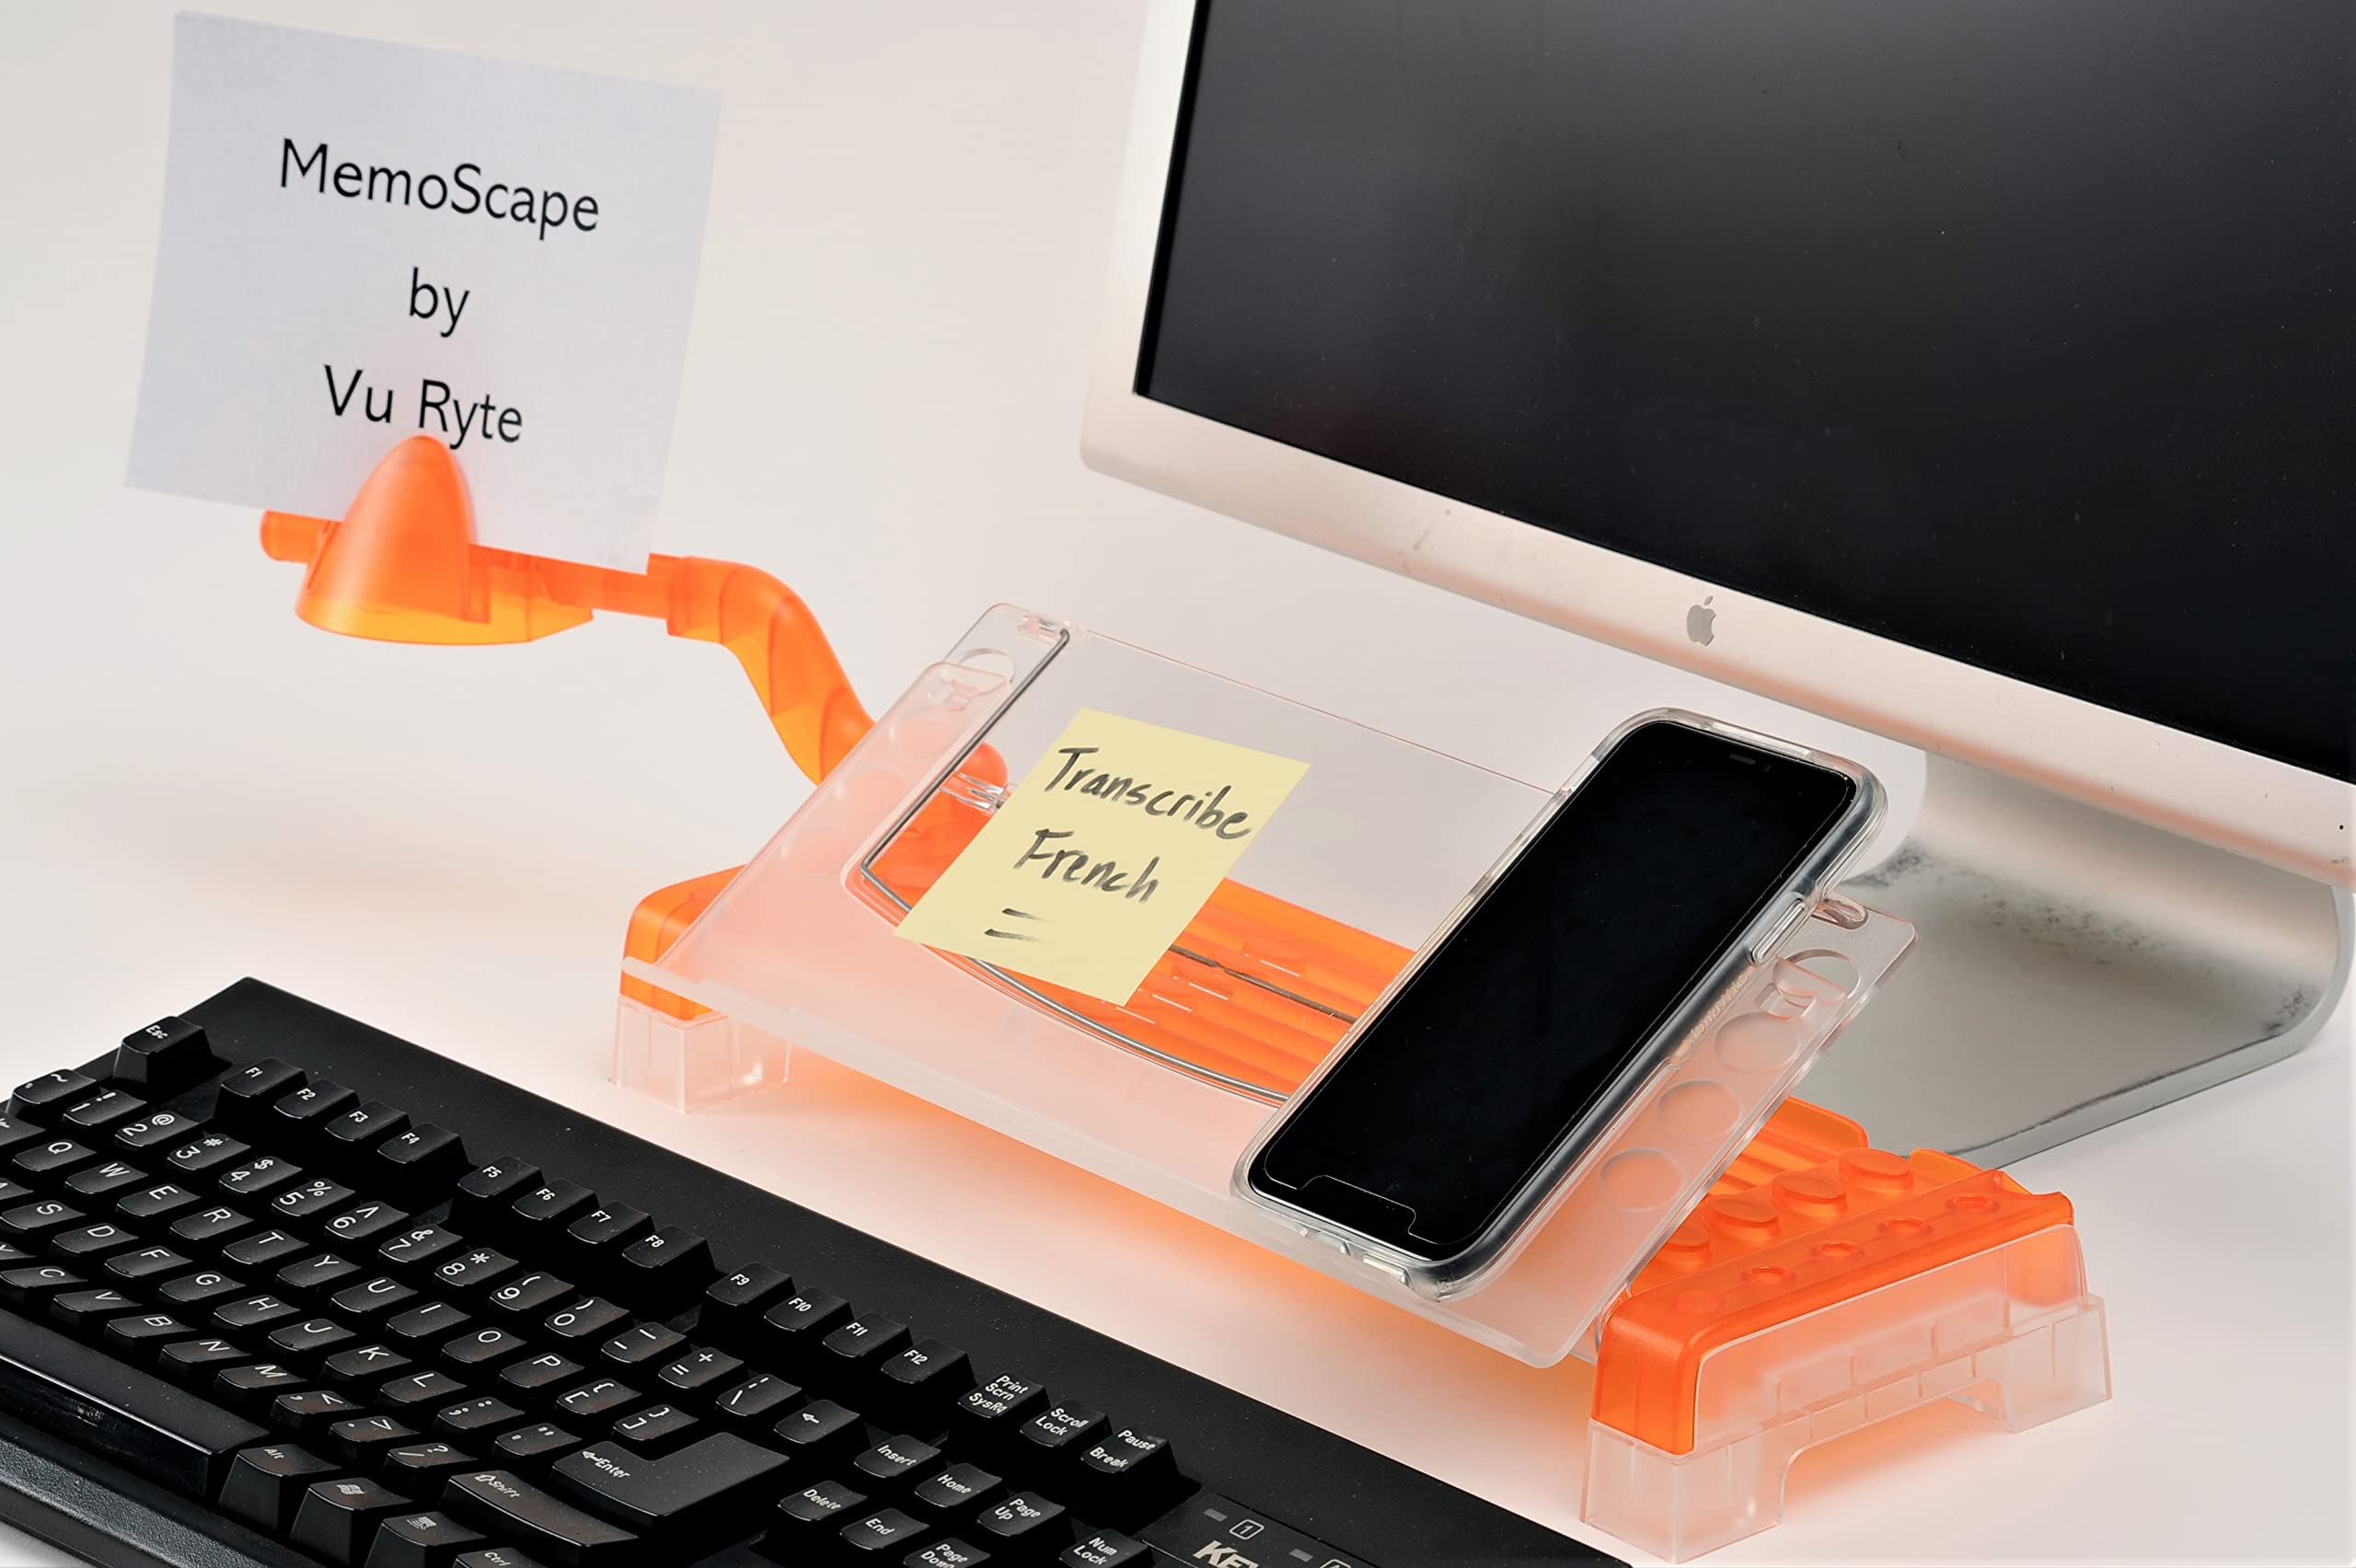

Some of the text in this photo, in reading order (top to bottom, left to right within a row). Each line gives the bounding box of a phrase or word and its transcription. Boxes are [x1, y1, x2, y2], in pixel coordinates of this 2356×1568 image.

[281, 137, 599, 241] MemoScape
[409, 266, 470, 339] by
[324, 364, 523, 451] Vu Ryte
[1044, 746, 1253, 841] Transcribe
[1012, 827, 1161, 905] French
[144, 1023, 169, 1041] Esc
[245, 1066, 263, 1078] F1
[296, 1088, 317, 1101] F2
[70, 1102, 91, 1113] 1
[349, 1111, 369, 1123] F3
[121, 1123, 148, 1137] 2
[400, 1132, 421, 1145] F4
[48, 1141, 73, 1155] Q
[176, 1145, 202, 1159] 3
[98, 1162, 131, 1178] W
[230, 1170, 251, 1182] 4
[482, 1165, 502, 1178] F5
[148, 1185, 179, 1201] E
[279, 1191, 306, 1206] 5
[536, 1188, 556, 1201] F6
[36, 1204, 64, 1216] S
[202, 1208, 232, 1223] R
[591, 1210, 612, 1223] F7
[332, 1216, 356, 1230] 6
[87, 1225, 115, 1238] D
[258, 1231, 284, 1244] T
[387, 1239, 412, 1252] 7
[644, 1234, 664, 1248] F8
[140, 1249, 170, 1258] F
[313, 1255, 340, 1267] Y
[40, 1268, 65, 1278] C
[442, 1262, 466, 1277] 8
[195, 1274, 221, 1286] G
[367, 1278, 396, 1294] U
[730, 1274, 750, 1286] F9
[95, 1291, 121, 1300] V
[497, 1286, 521, 1300] 9
[248, 1297, 279, 1311] H
[788, 1297, 812, 1312] F10
[144, 1316, 173, 1327] B
[553, 1313, 576, 1326] 0
[304, 1322, 332, 1333] J
[846, 1321, 869, 1337] F11
[478, 1331, 502, 1343] O
[199, 1341, 230, 1352] N
[358, 1346, 389, 1361] K
[532, 1355, 561, 1366] P
[904, 1349, 929, 1366] F12
[254, 1365, 288, 1378] M
[412, 1373, 434, 1388] L
[996, 1375, 1029, 1395] Print
[985, 1382, 1015, 1401] Scrn
[968, 1391, 1009, 1414] SysRq
[1050, 1407, 1090, 1428] Scroll
[1034, 1415, 1068, 1436] Lock
[1117, 1429, 1156, 1450] Pause
[264, 1448, 284, 1459] Alt
[877, 1445, 918, 1466] Insert
[1090, 1447, 1128, 1468] Break
[595, 1457, 630, 1478] Enter
[488, 1478, 522, 1500] Shift
[937, 1473, 972, 1494] Home
[803, 1488, 841, 1510] Delete
[994, 1505, 1013, 1521] Up
[1009, 1497, 1042, 1519] Page
[865, 1517, 895, 1535] End
[1240, 1525, 1254, 1535] 1
[935, 1543, 968, 1563] Page
[1088, 1536, 1118, 1556] Num
[1193, 1539, 1260, 1568] KE
[484, 1551, 511, 1566] Ctrl
[1072, 1544, 1108, 1566] Lock
